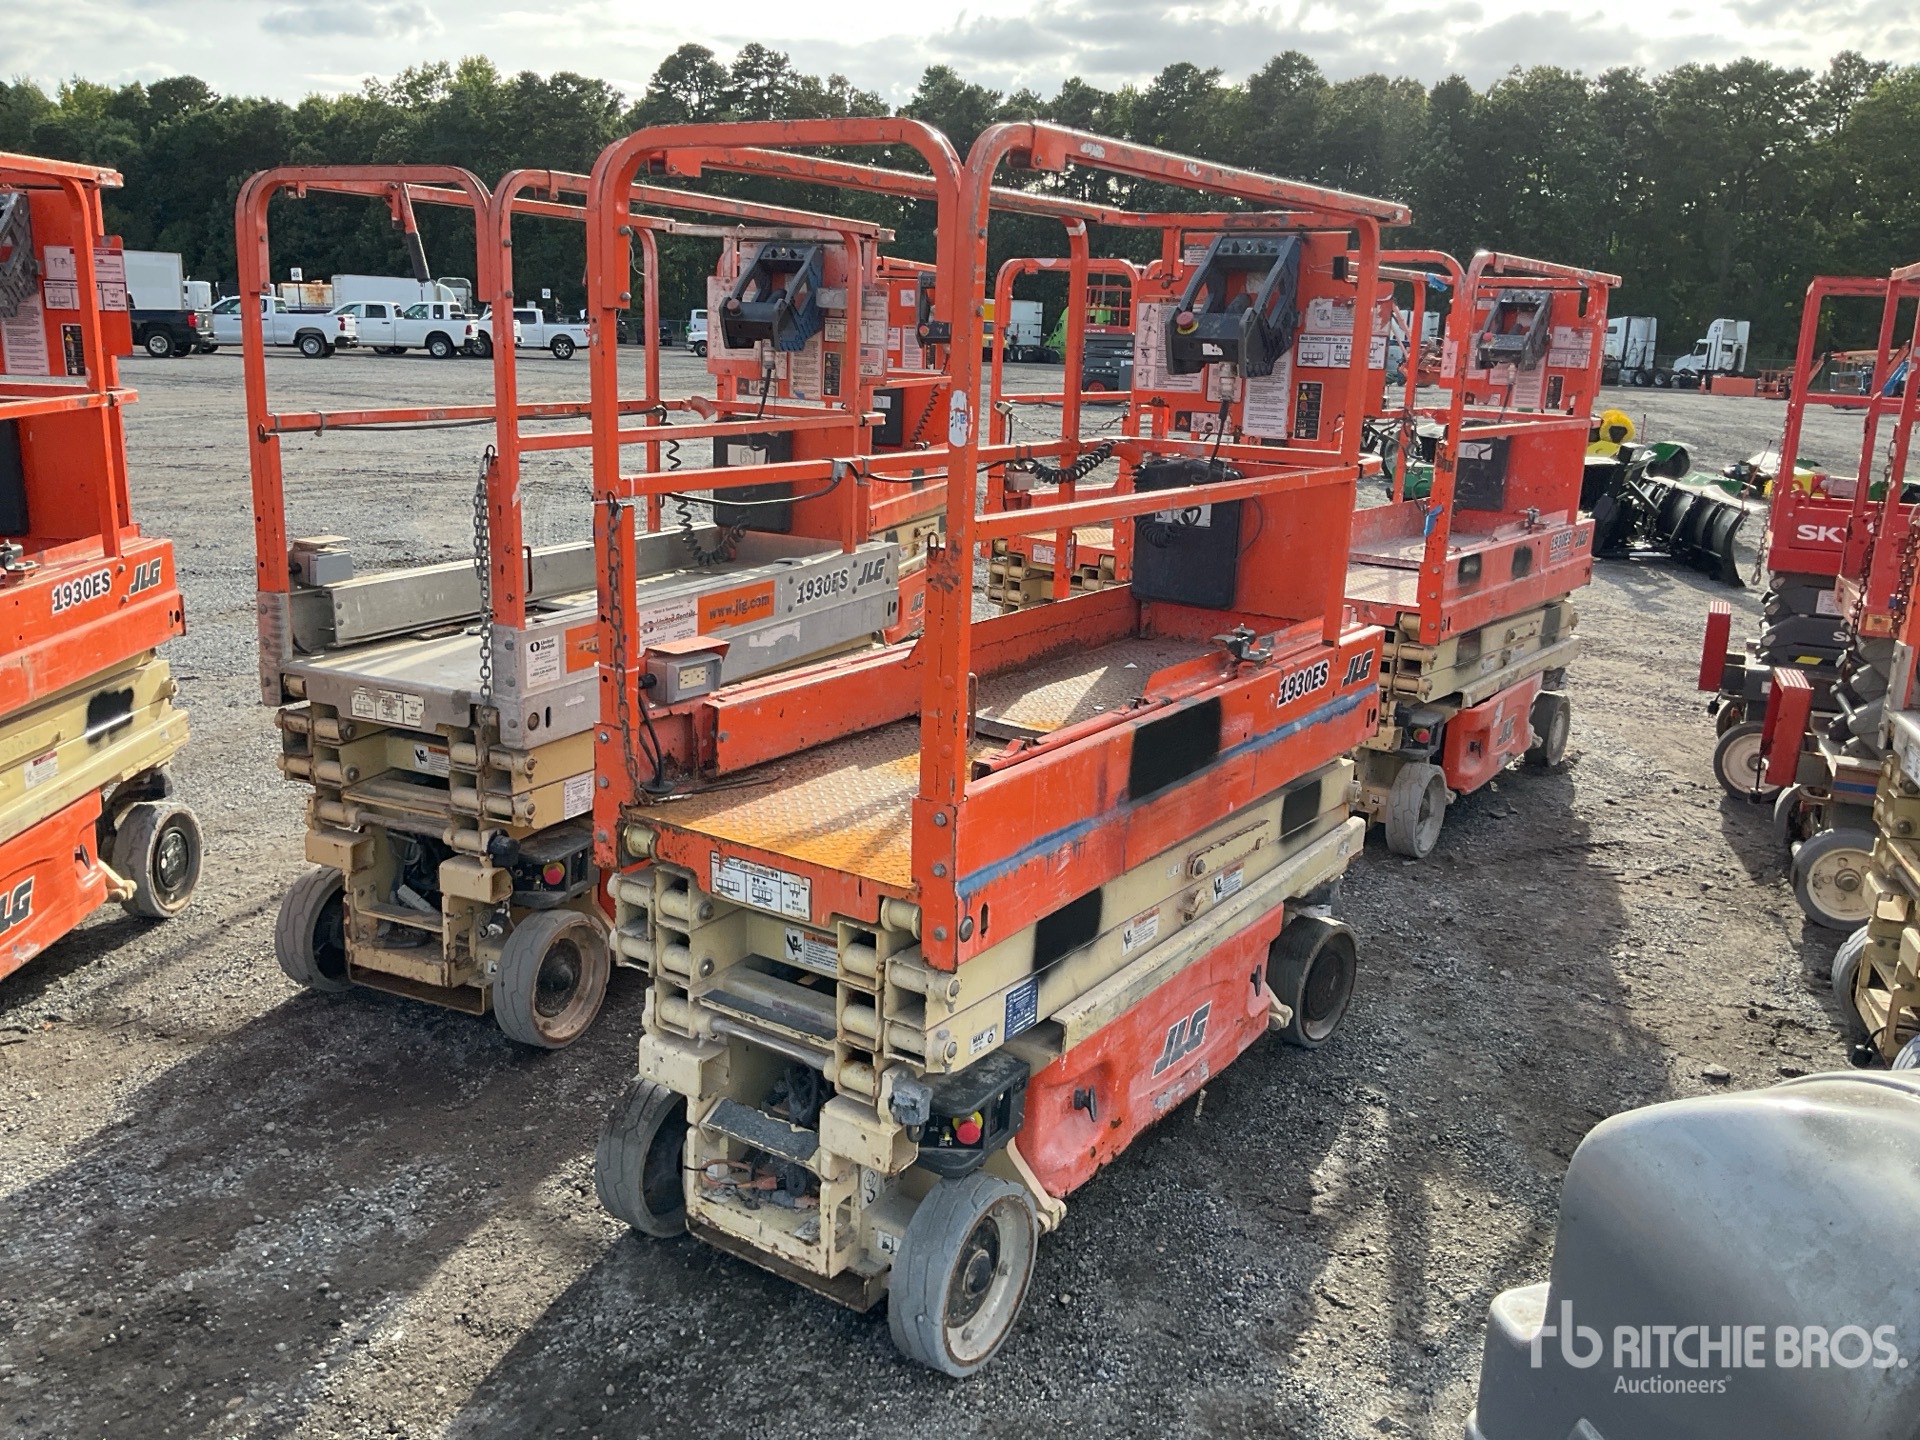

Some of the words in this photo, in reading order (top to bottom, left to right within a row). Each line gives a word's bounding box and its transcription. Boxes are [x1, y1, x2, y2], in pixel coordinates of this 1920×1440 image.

[54, 571, 111, 612] 1930ES
[130, 558, 161, 595] JLG
[709, 595, 769, 620] www.jlg.com
[796, 569, 848, 605] 1930ES
[858, 558, 886, 586] JLG
[911, 593, 925, 613] JLG
[1278, 661, 1329, 706] 1930ES
[1342, 650, 1374, 687] JLG
[0, 875, 34, 936] LG
[1152, 1001, 1211, 1078] JLG
